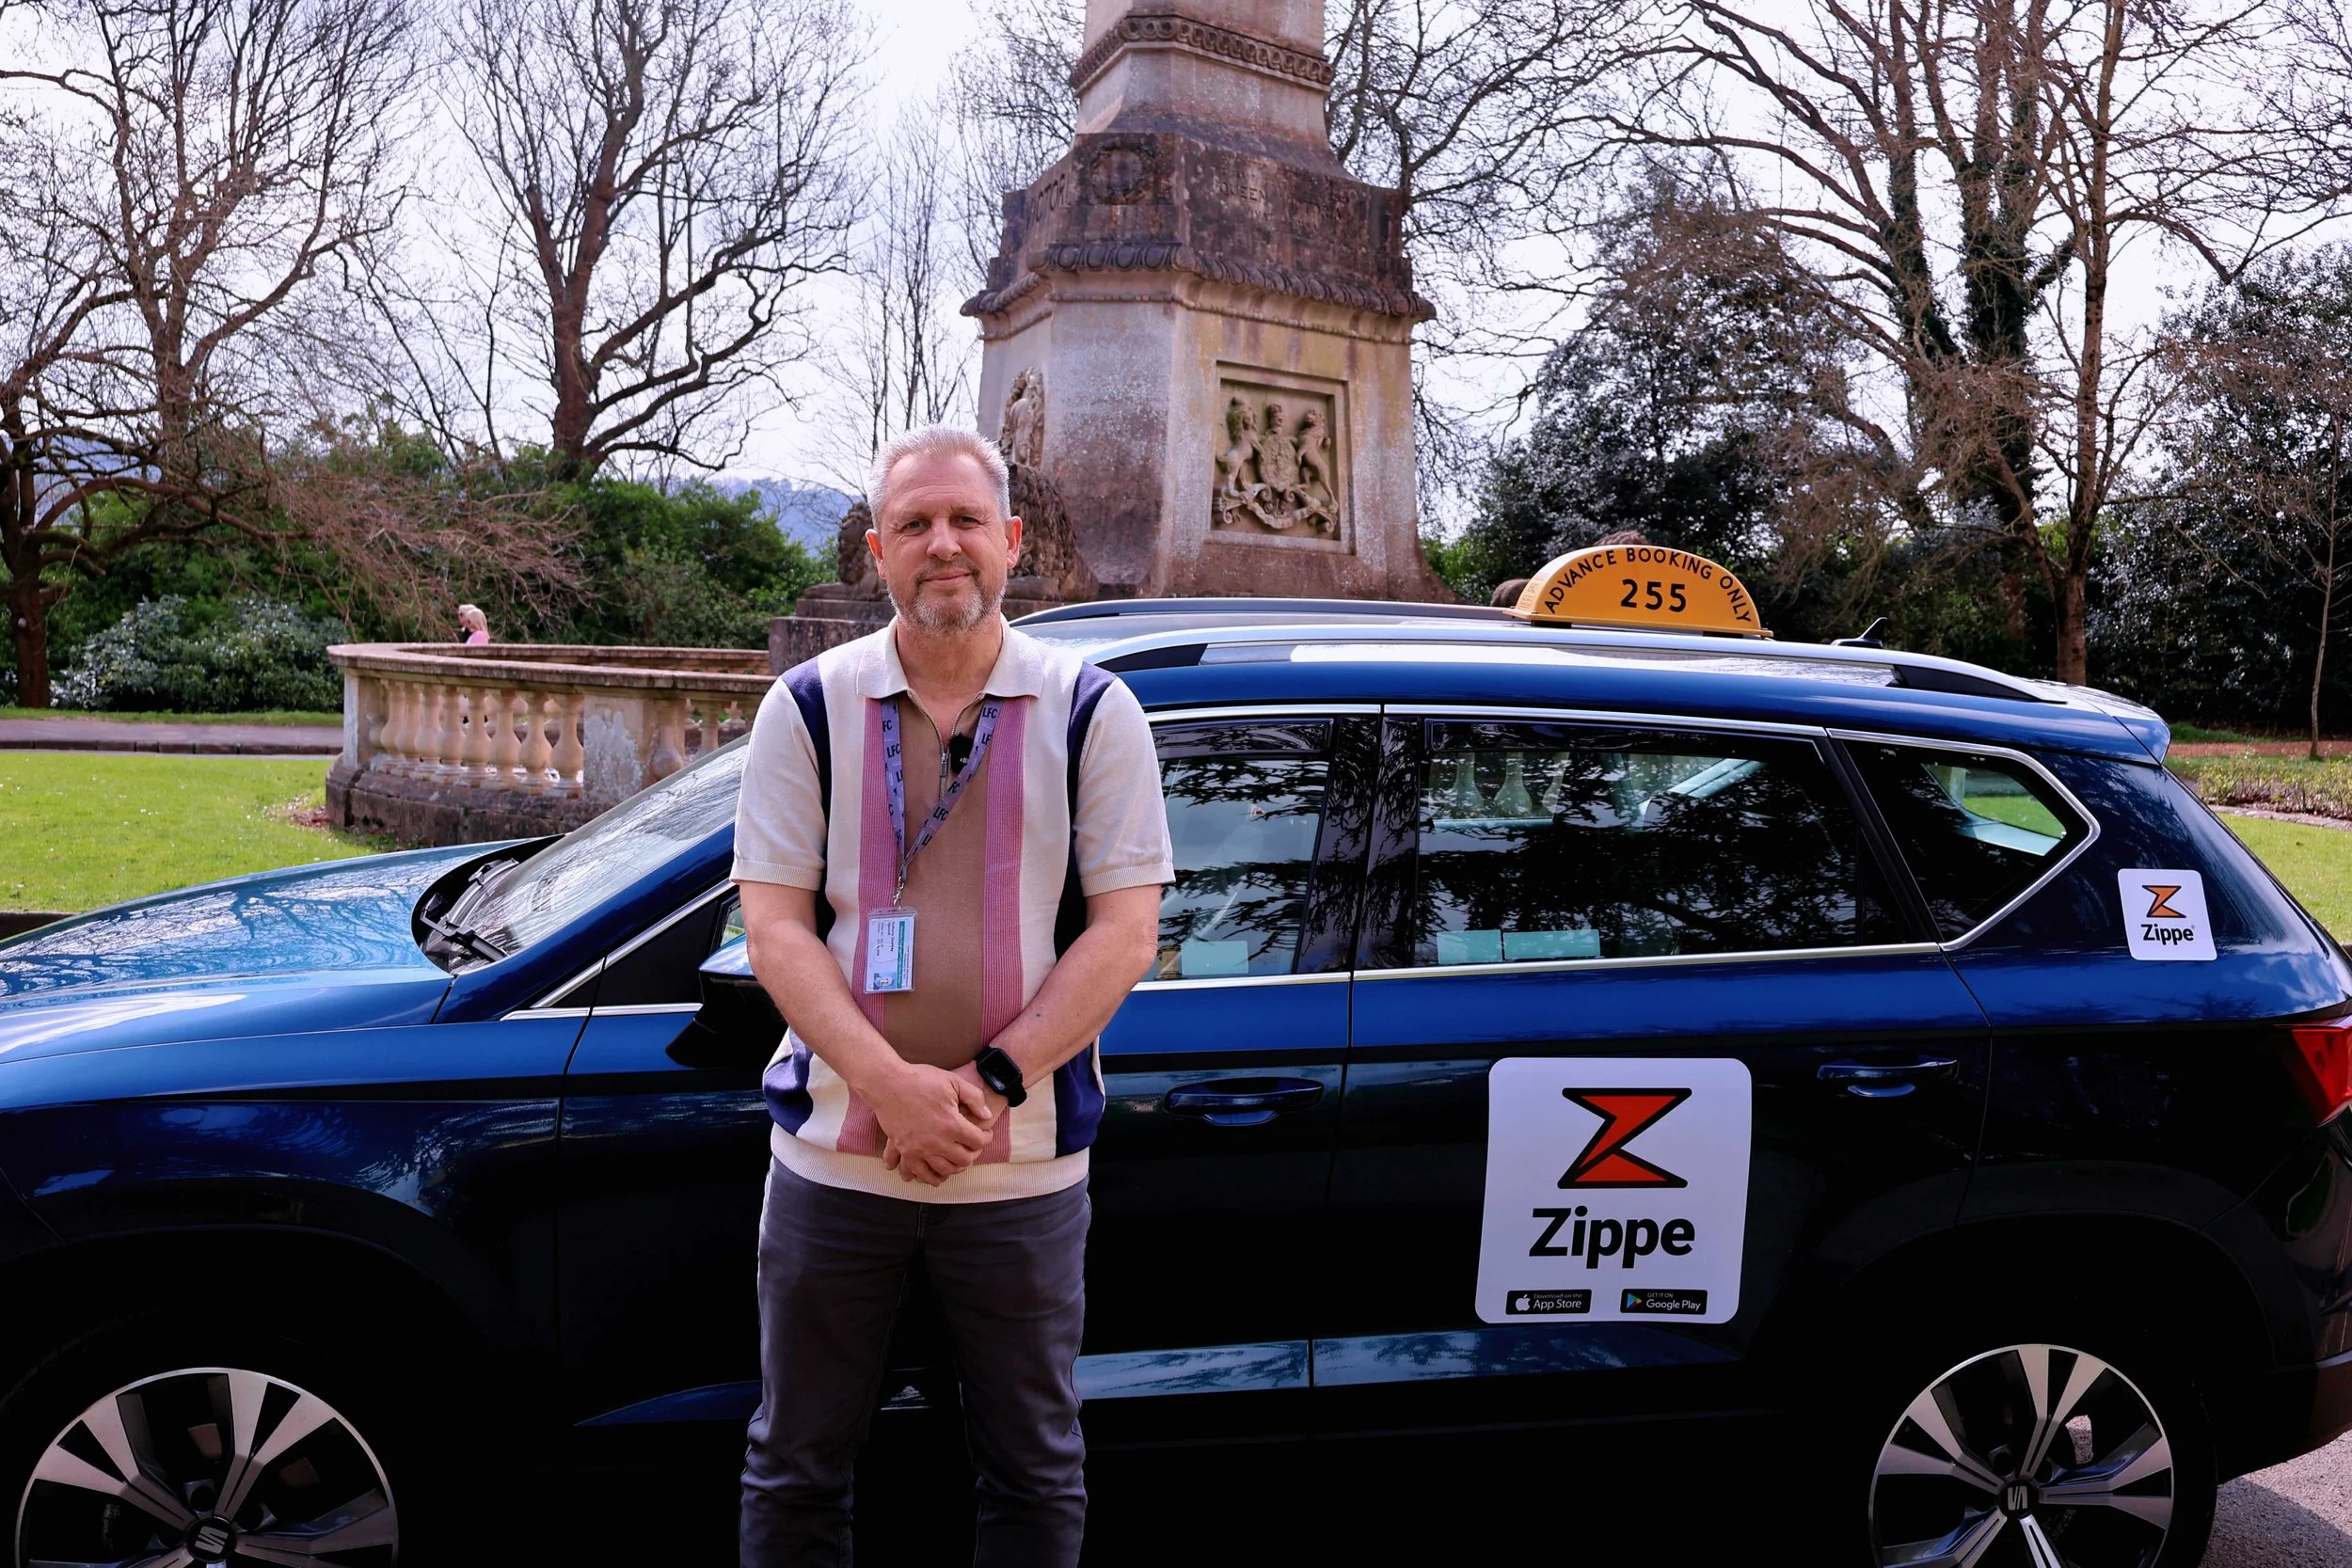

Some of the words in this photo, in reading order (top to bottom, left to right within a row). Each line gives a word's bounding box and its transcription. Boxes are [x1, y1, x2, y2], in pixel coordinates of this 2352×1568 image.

[1544, 549, 1617, 614] ADVANCE
[1627, 547, 1713, 579] BOOKING
[1719, 575, 1752, 623] ONLY
[1620, 578, 1687, 613] 255
[982, 706, 998, 719] LFC
[882, 720, 893, 732] FC
[981, 733, 992, 745] LF
[886, 743, 901, 758] LFC
[947, 781, 961, 794] FC
[932, 806, 949, 821] LFC
[2140, 924, 2195, 945] Zippe
[1529, 1205, 1695, 1269] Zippe
[1533, 1299, 1554, 1311] App
[1556, 1299, 1581, 1308] Store
[1646, 1298, 1680, 1310] Google
[1681, 1299, 1701, 1311] Play
